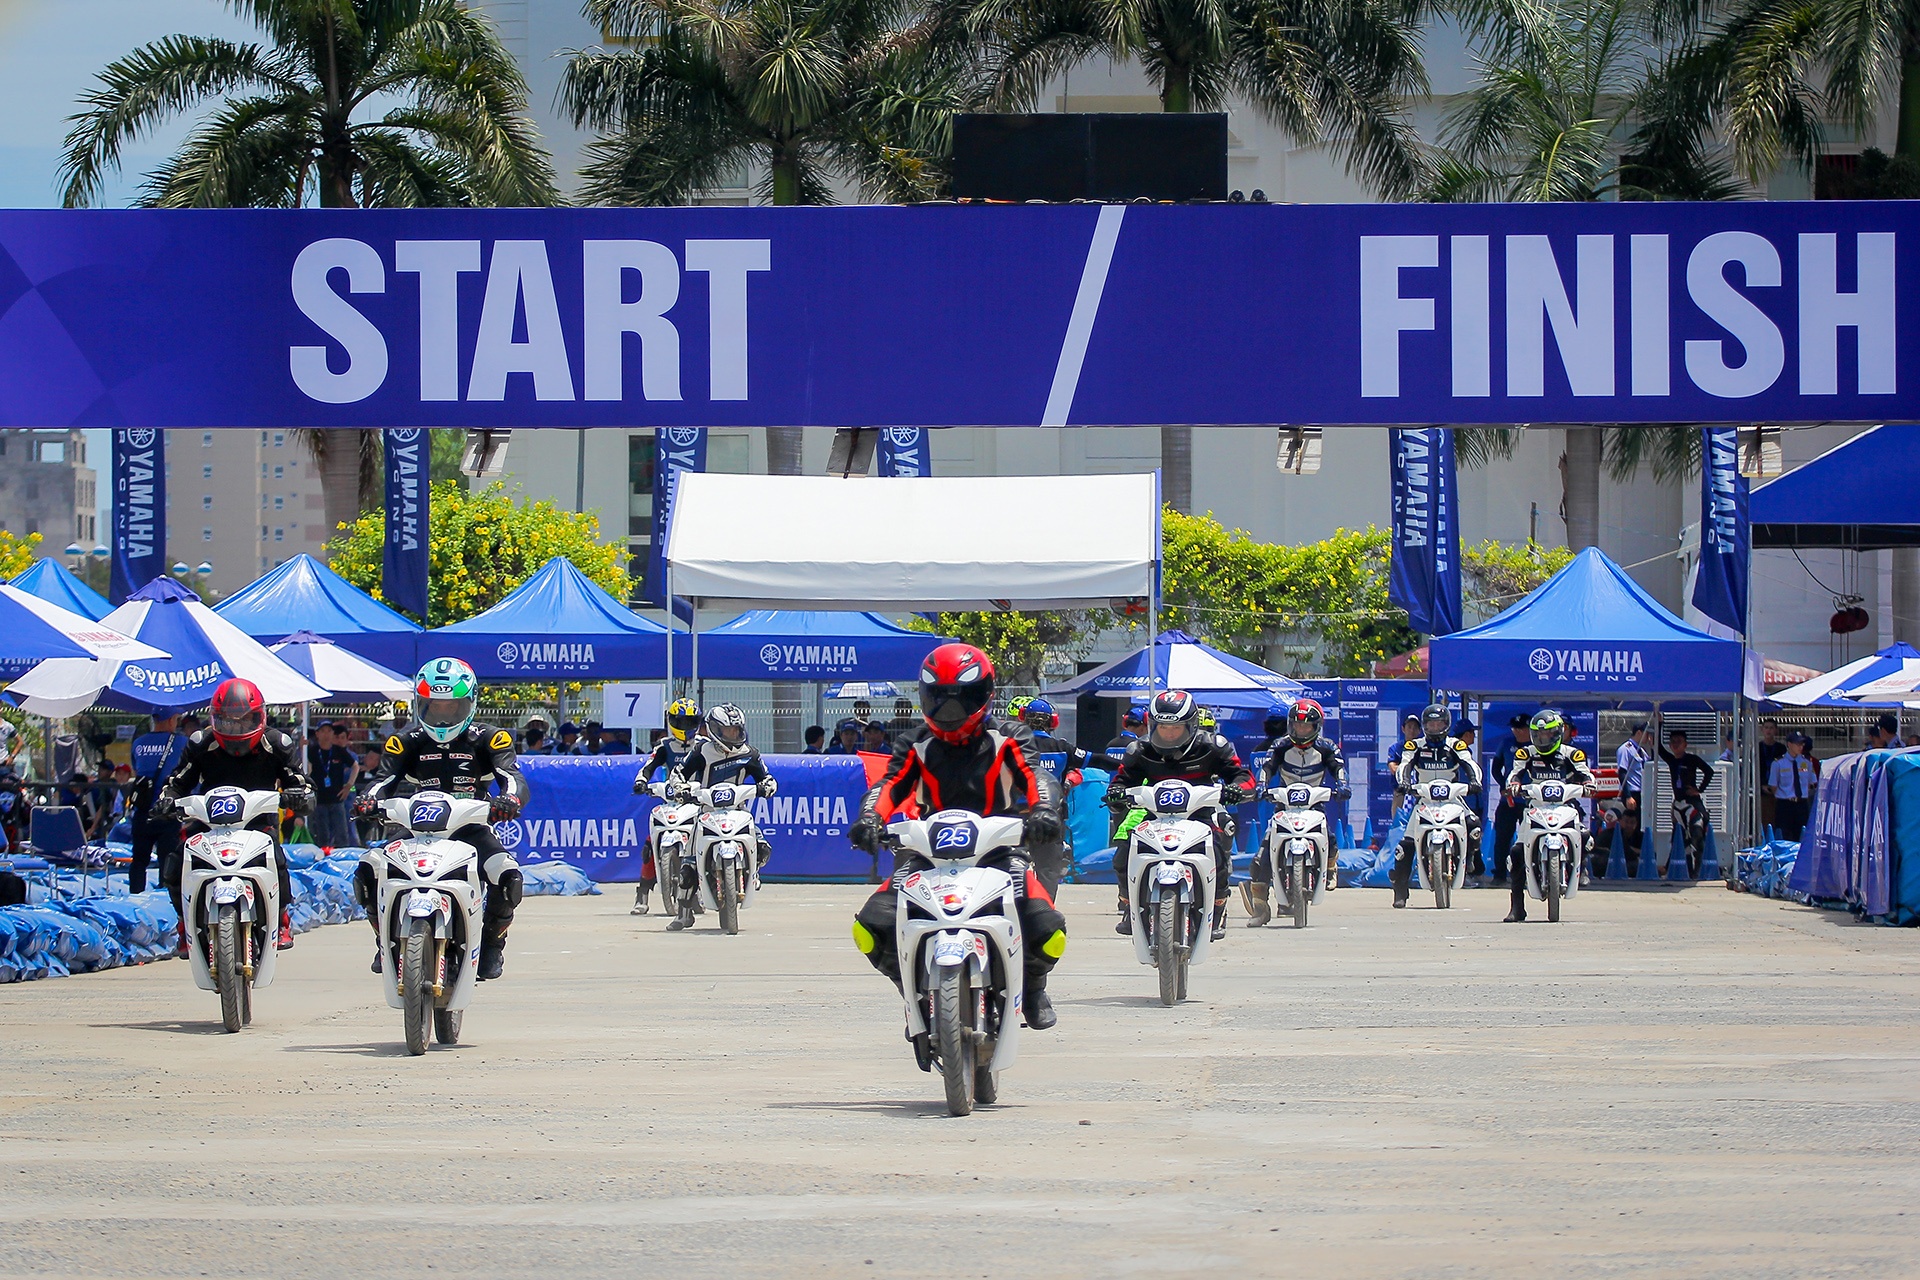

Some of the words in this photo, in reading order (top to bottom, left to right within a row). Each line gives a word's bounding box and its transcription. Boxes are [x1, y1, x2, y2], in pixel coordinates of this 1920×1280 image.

[290, 238, 771, 403] START
[1360, 231, 1896, 399] FINISH
[118, 430, 126, 550] RACING
[396, 444, 419, 551] YAMAHA
[1401, 429, 1429, 547] YAMAHA
[1712, 430, 1736, 554] YAMAHA
[128, 450, 154, 558] YAMAHA
[520, 643, 595, 662] YAMAHA
[782, 645, 858, 665] YAMAHA
[1555, 650, 1643, 673] YAMAHA
[148, 661, 222, 686] YAMAHA
[624, 693, 641, 717] 7
[211, 798, 238, 818] 26
[714, 790, 733, 803] 29
[1159, 790, 1185, 806] 38
[1290, 791, 1307, 802] 23
[413, 805, 444, 824] 27
[524, 818, 638, 848] YAMAHA
[762, 828, 841, 836] CING
[936, 827, 971, 850] 25
